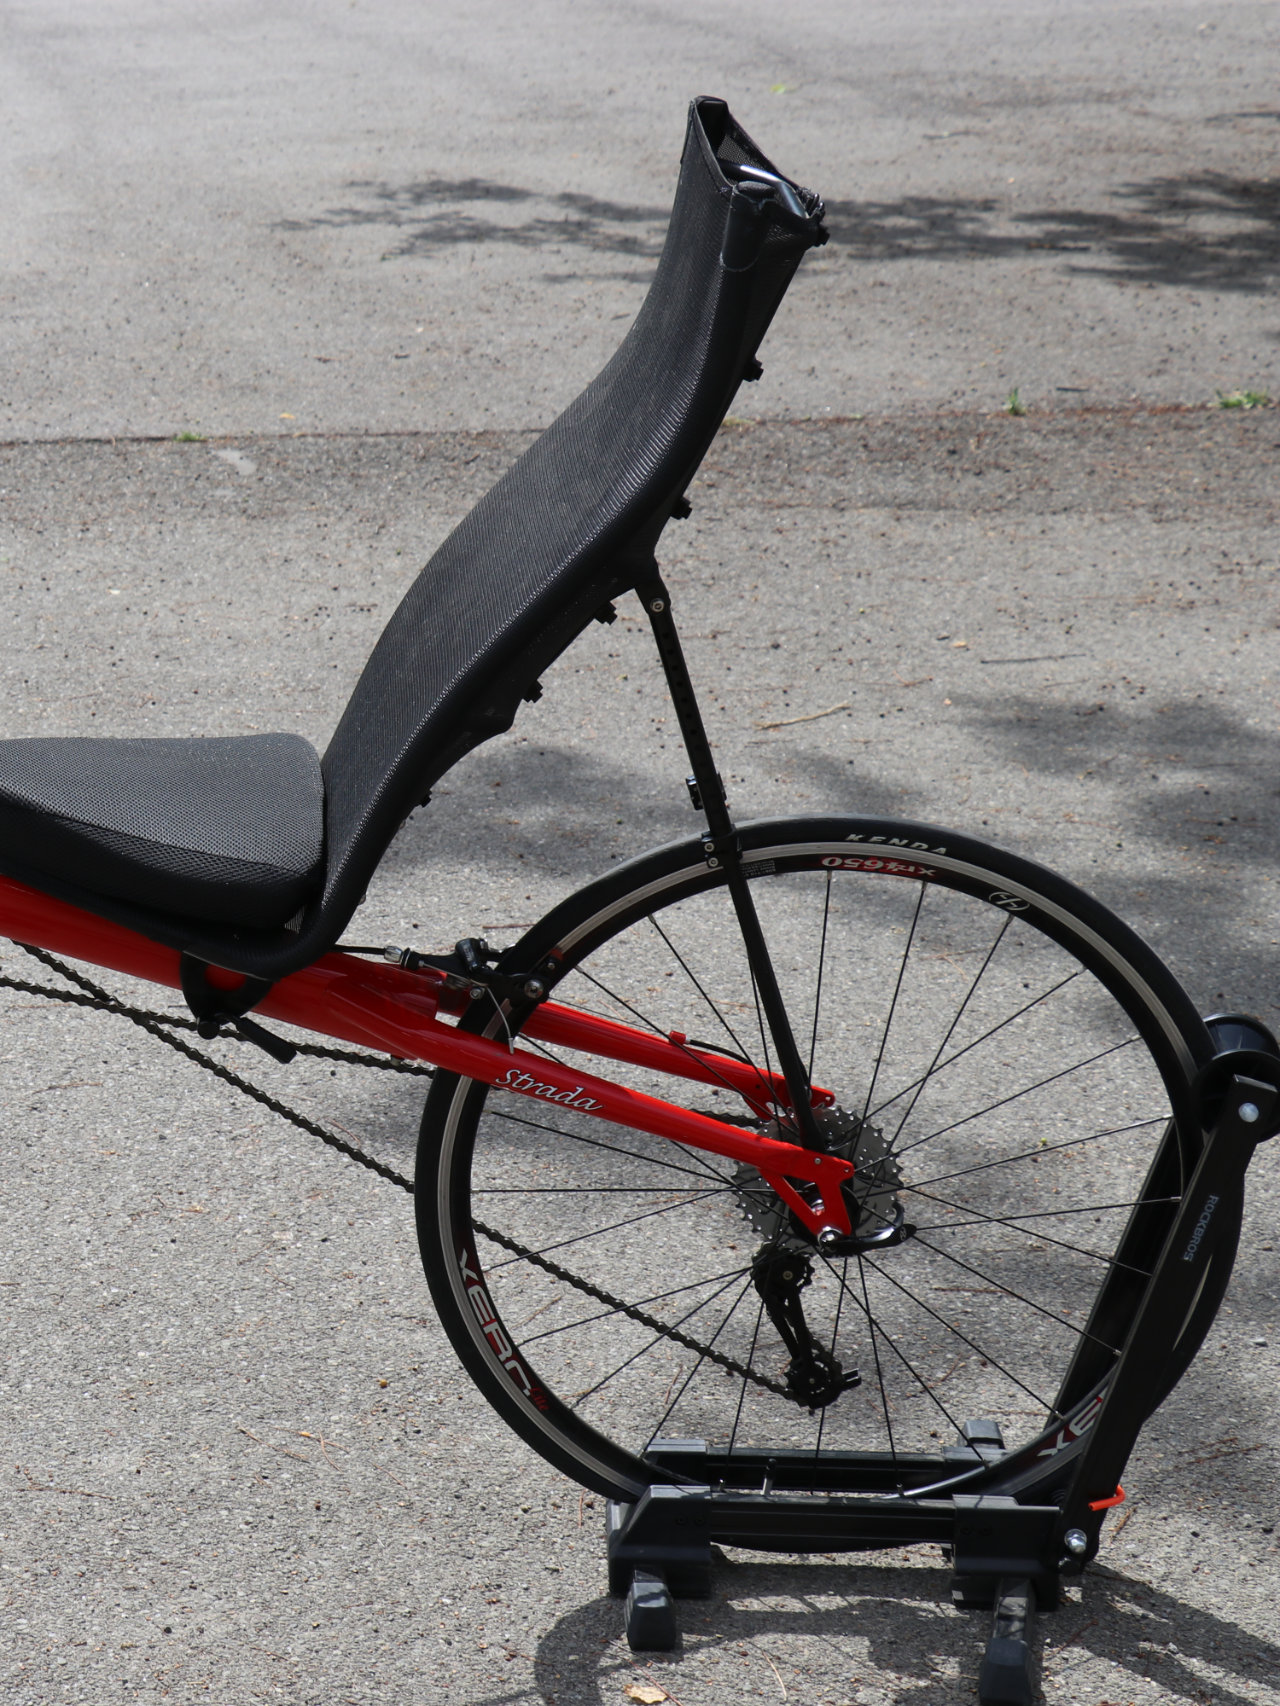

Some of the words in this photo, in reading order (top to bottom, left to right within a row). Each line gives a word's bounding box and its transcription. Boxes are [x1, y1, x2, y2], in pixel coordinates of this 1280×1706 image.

[844, 833, 948, 856] KENDA
[495, 1069, 603, 1111] Strada
[1183, 1194, 1220, 1262] ROCKBROS
